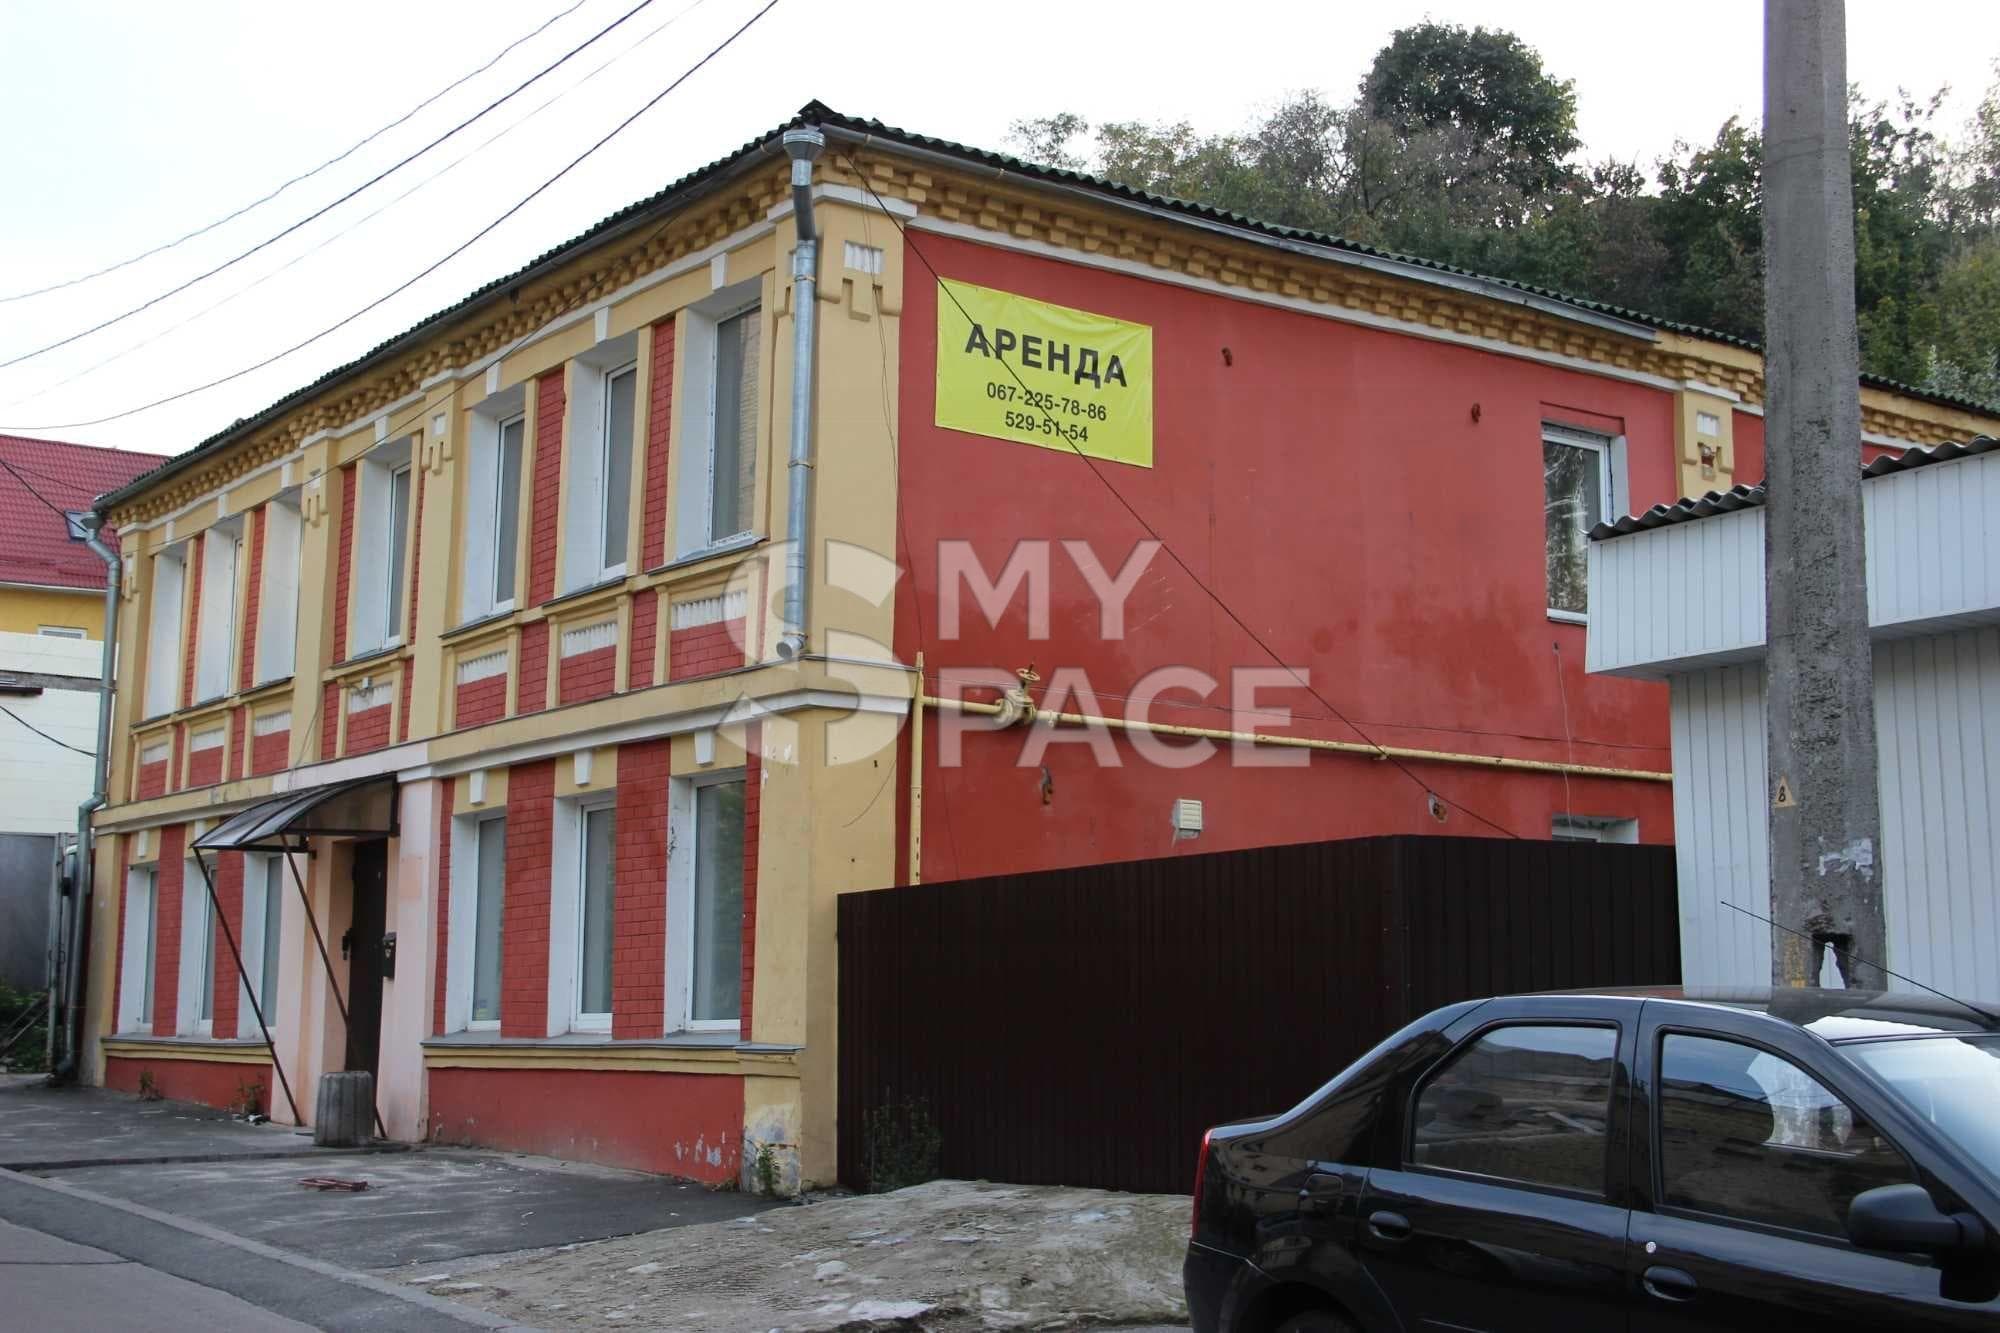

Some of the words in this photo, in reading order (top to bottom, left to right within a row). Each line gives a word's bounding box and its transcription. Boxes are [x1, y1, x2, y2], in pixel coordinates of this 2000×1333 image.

[965, 323, 1127, 389] АРЕНДА
[986, 382, 1107, 421] 067-225-78-86
[1005, 411, 1088, 442] 529-51-54
